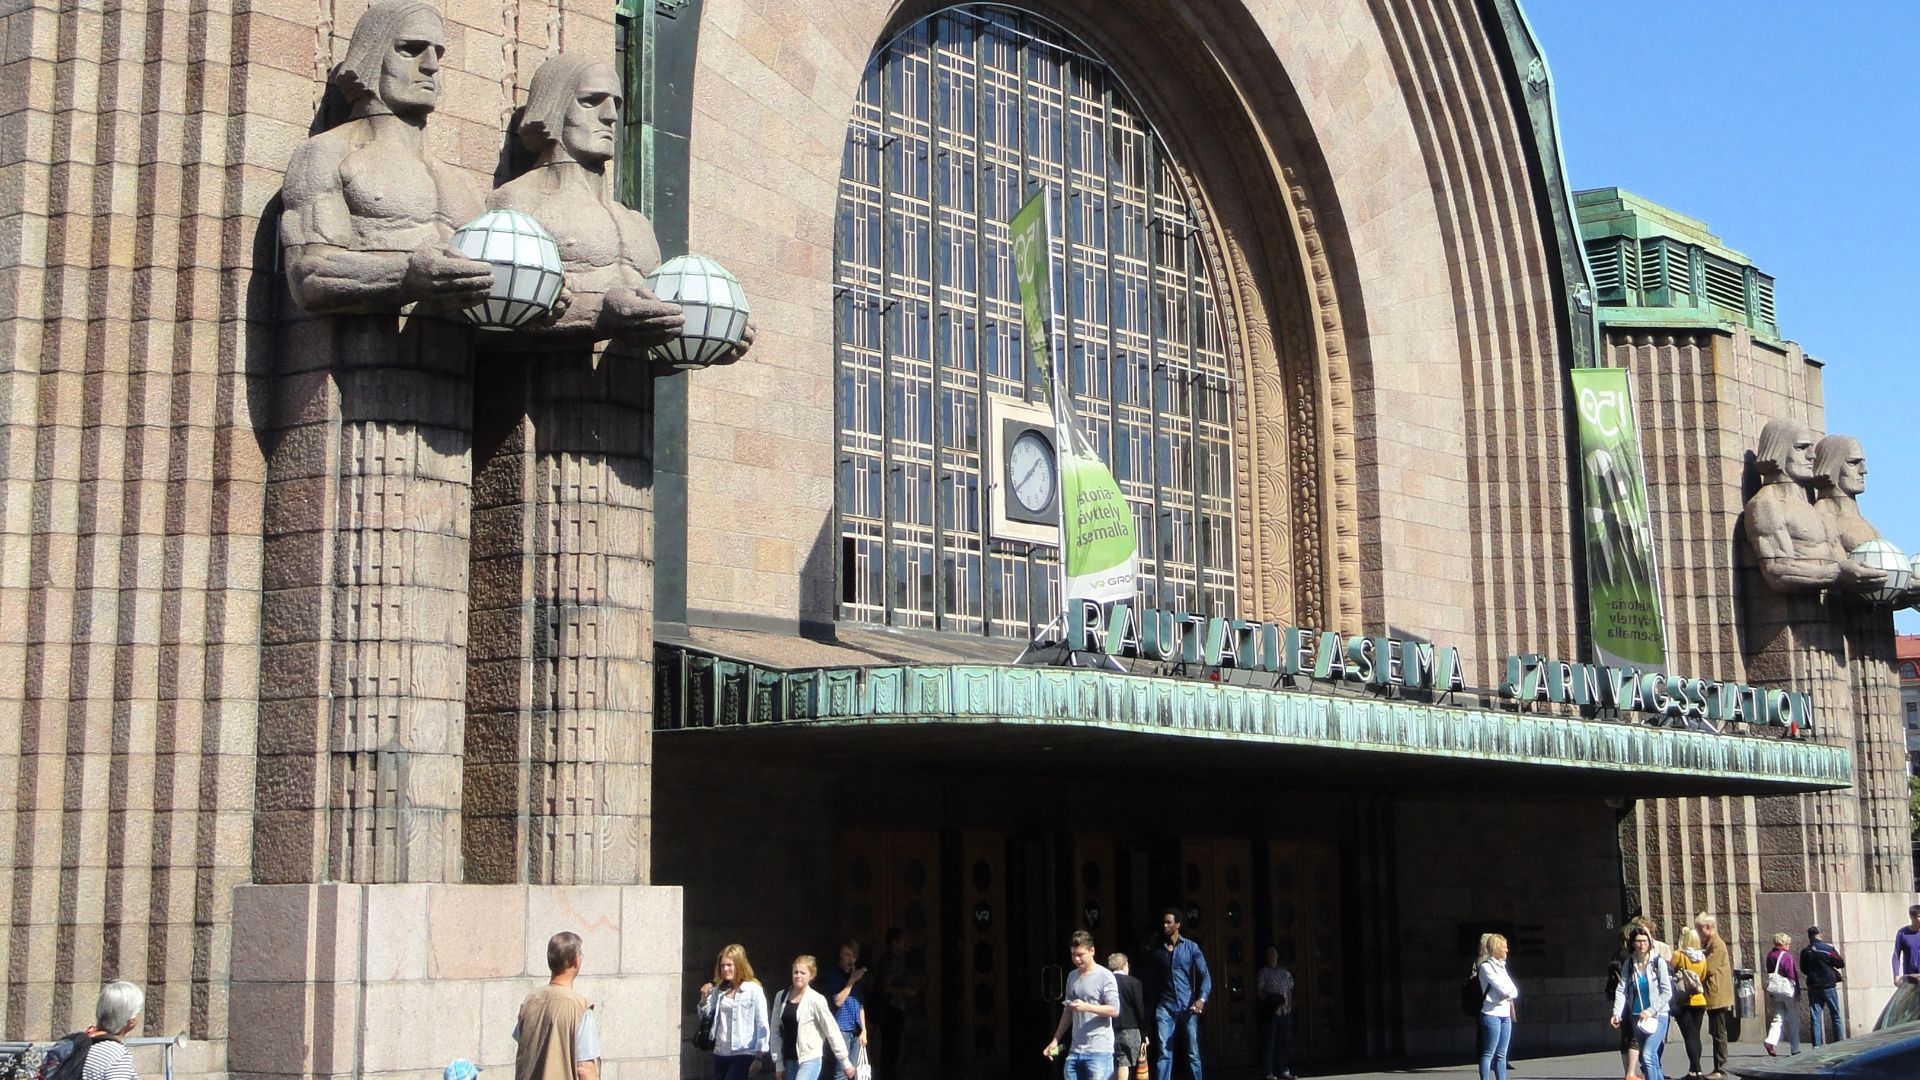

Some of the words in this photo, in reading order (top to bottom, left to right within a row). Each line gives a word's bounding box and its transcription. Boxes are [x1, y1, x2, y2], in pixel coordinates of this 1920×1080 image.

[1076, 520, 1129, 547] asemalla
[1107, 573, 1135, 586] GRO
[1070, 599, 1467, 693] RAUTATIEASEMA
[1502, 654, 1815, 730] JÄRNVÄGSSTATION
